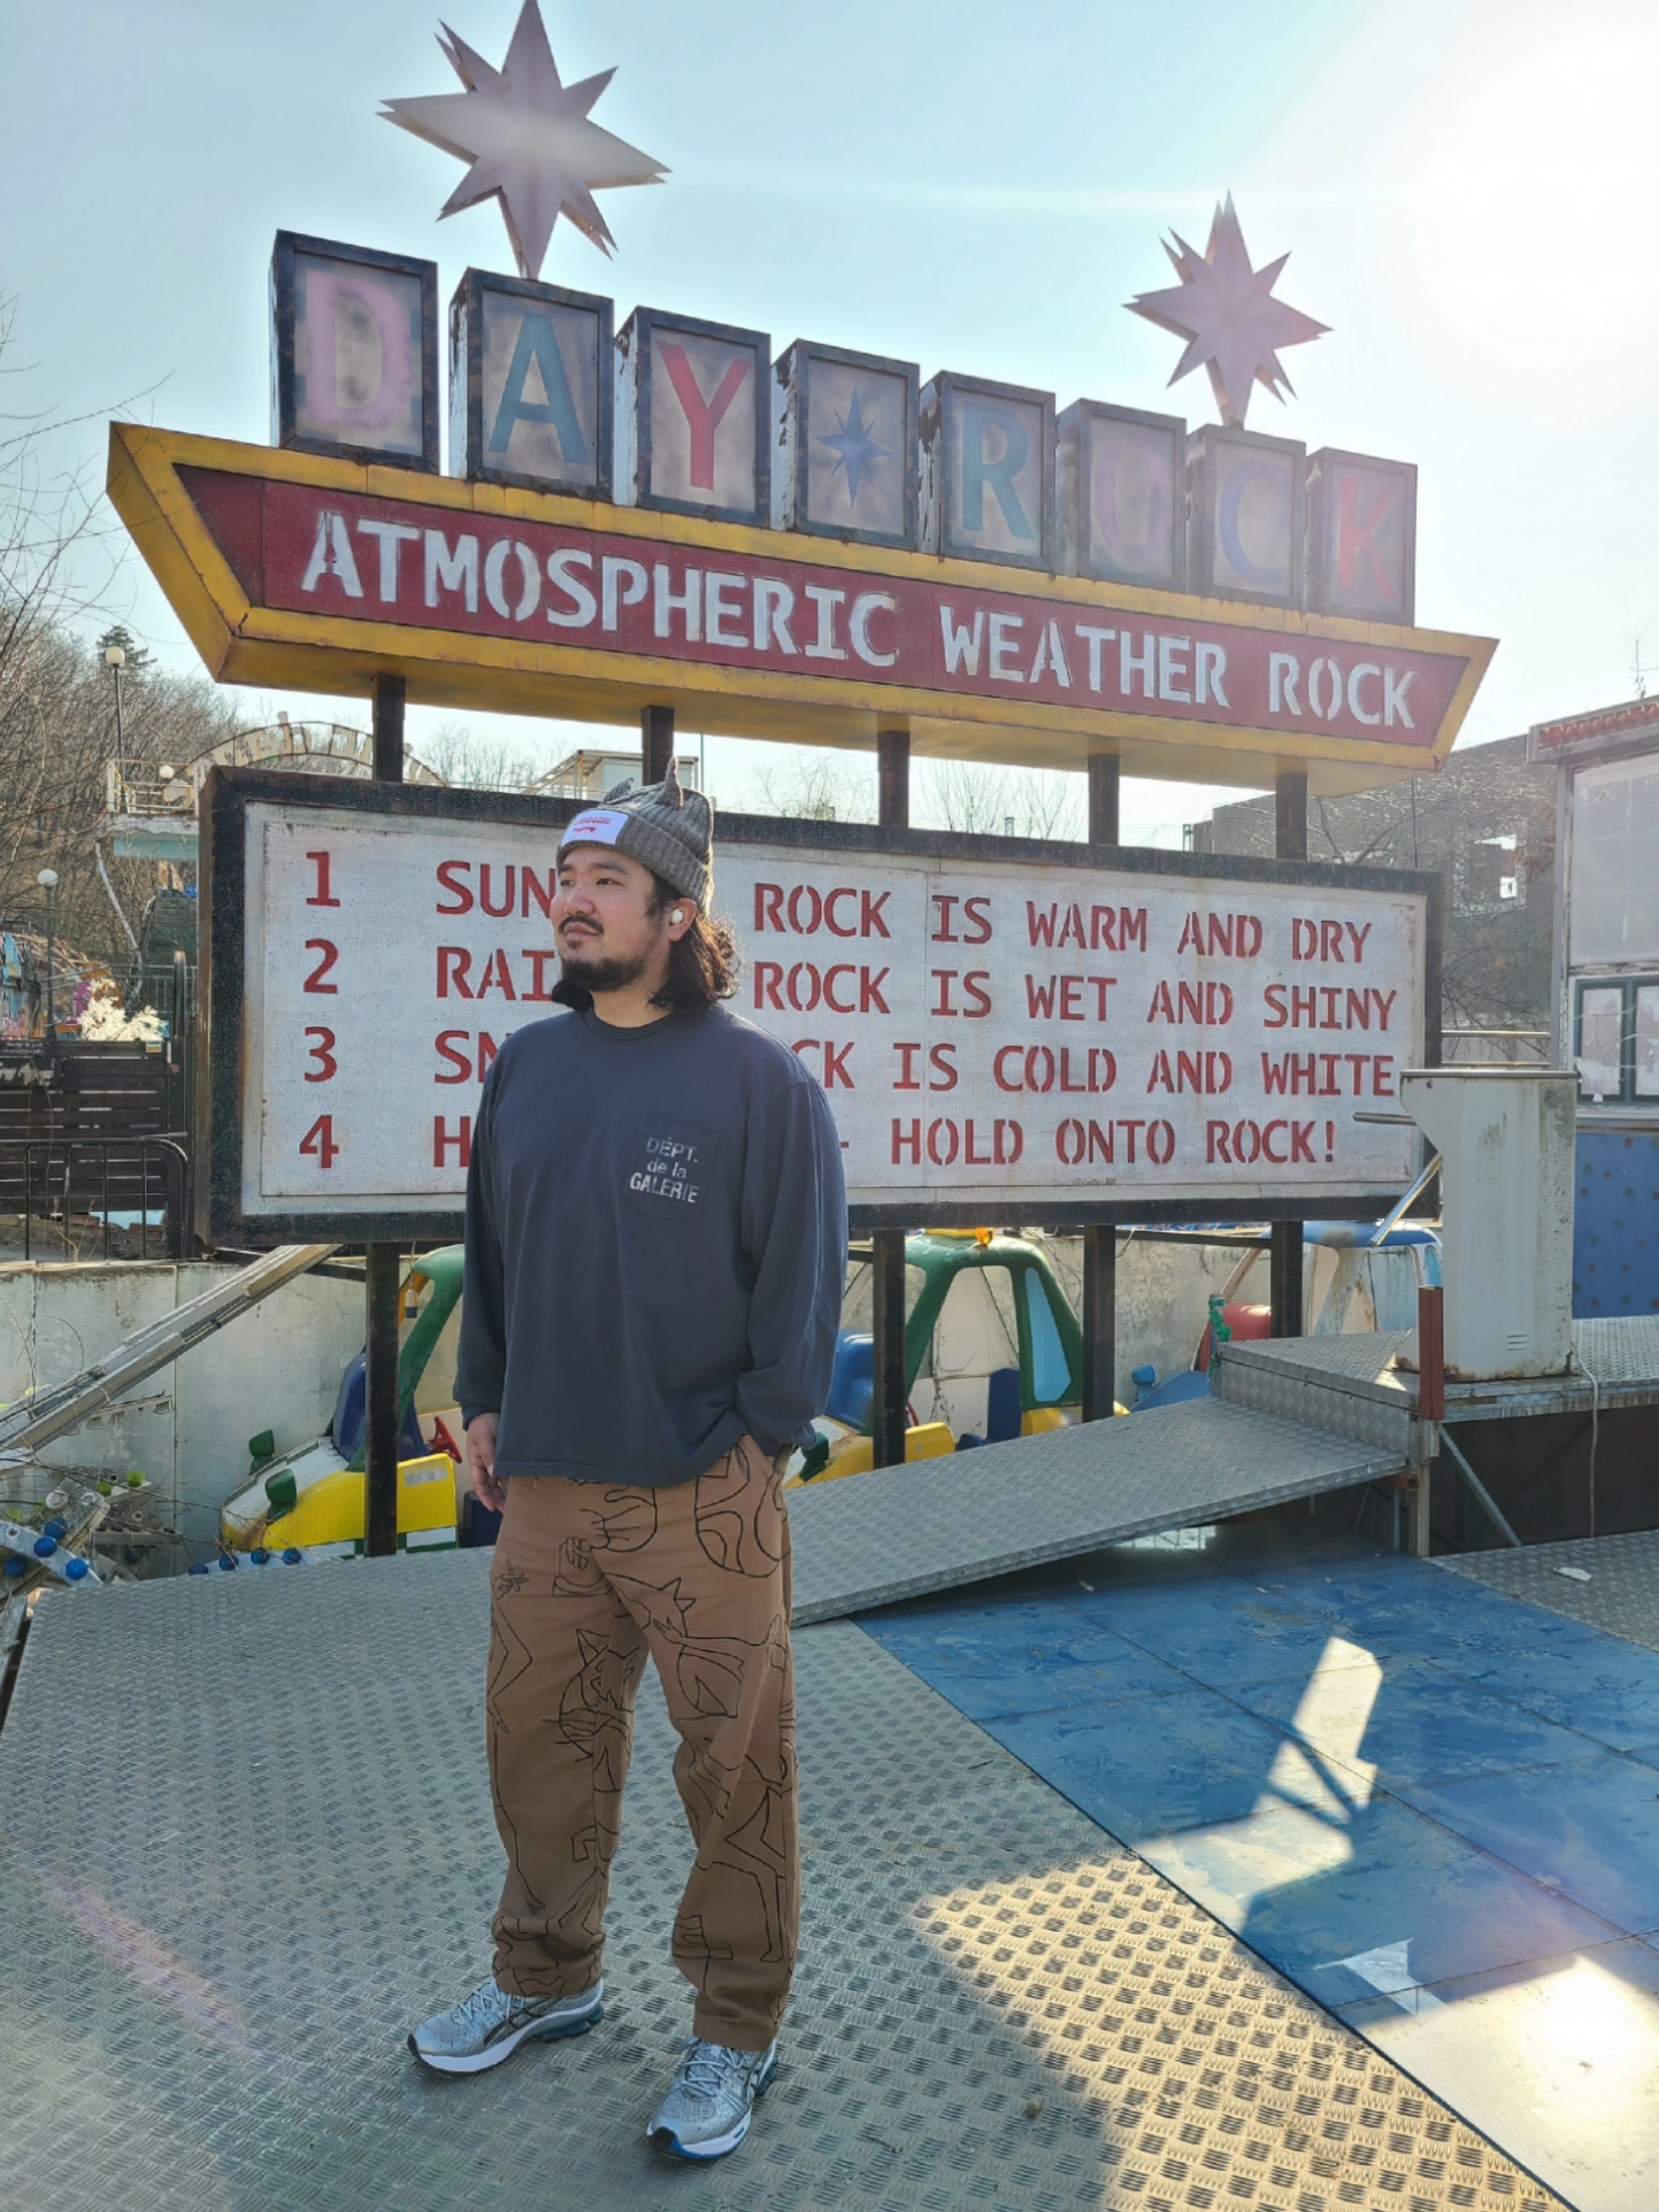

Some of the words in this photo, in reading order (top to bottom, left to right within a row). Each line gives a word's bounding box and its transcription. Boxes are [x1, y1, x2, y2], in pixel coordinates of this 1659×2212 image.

[306, 271, 753, 491] DAY
[962, 402, 1397, 600] ROCK
[301, 510, 900, 667] ATMOSPHERIC
[940, 604, 1230, 709] WEATHER
[1269, 651, 1417, 729] ROCK
[306, 852, 341, 907] 1
[436, 860, 556, 919] SUN
[754, 883, 891, 938] ROCK
[931, 895, 993, 945] IS
[1026, 900, 1147, 952] WARM
[1177, 911, 1263, 958] AND
[1292, 918, 1371, 964] DRY
[303, 938, 339, 994] 2
[436, 946, 555, 1002] RAI
[753, 961, 891, 1014] ROCK
[931, 970, 992, 1018] IS
[1025, 974, 1117, 1022] WET
[1147, 980, 1234, 1026] AND
[1263, 984, 1397, 1031] SHINY
[304, 1027, 337, 1083] 3
[893, 1043, 958, 1092] IS
[993, 1045, 1117, 1093] COLD
[1147, 1050, 1233, 1094] AND
[1261, 1052, 1395, 1096] WHITE
[299, 1115, 340, 1169] 4
[891, 1118, 1024, 1166] HOLD
[1054, 1118, 1176, 1164] ONTO
[1206, 1118, 1336, 1164] ROCK!
[647, 1157, 667, 1173] de
[672, 1162, 687, 1179] la
[630, 1172, 700, 1203] GALERIE
